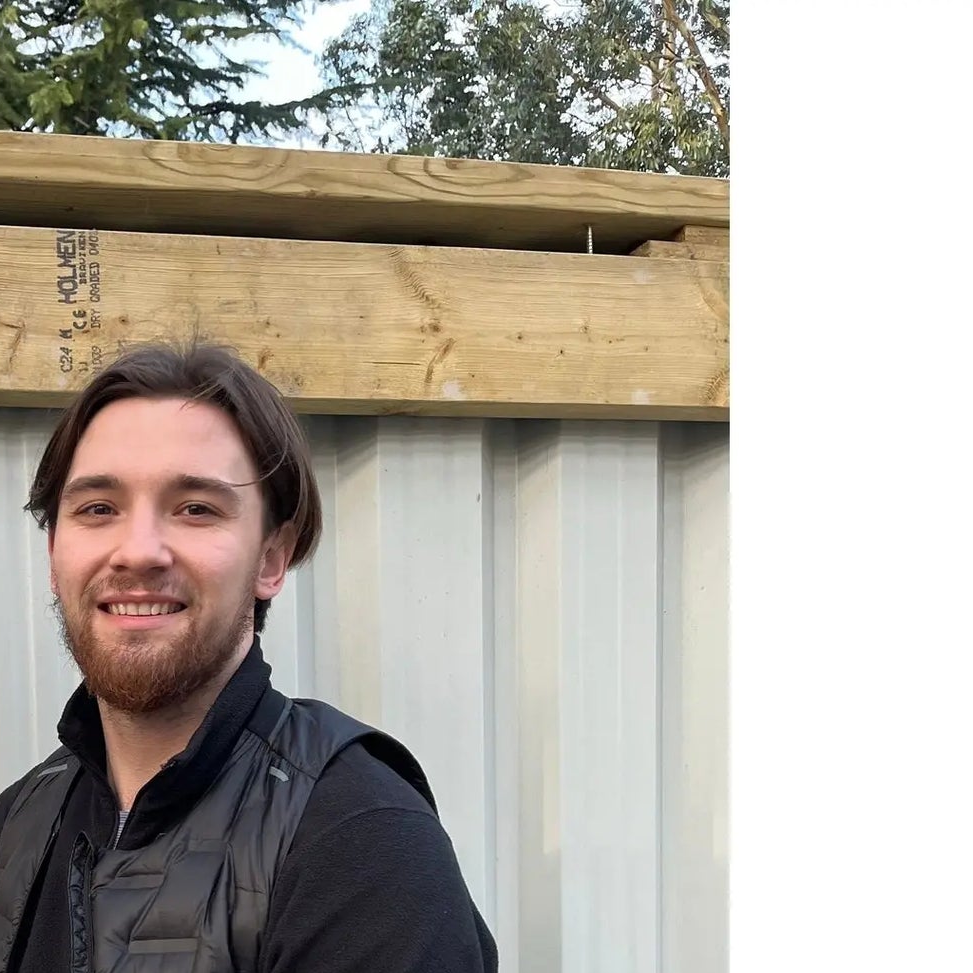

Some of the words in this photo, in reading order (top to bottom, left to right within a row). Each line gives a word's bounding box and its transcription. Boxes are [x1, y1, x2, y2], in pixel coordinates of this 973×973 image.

[56, 229, 78, 305] HOLMEN
[89, 262, 101, 303] GRADED
[90, 309, 101, 329] DRY
[59, 346, 73, 374] C24
